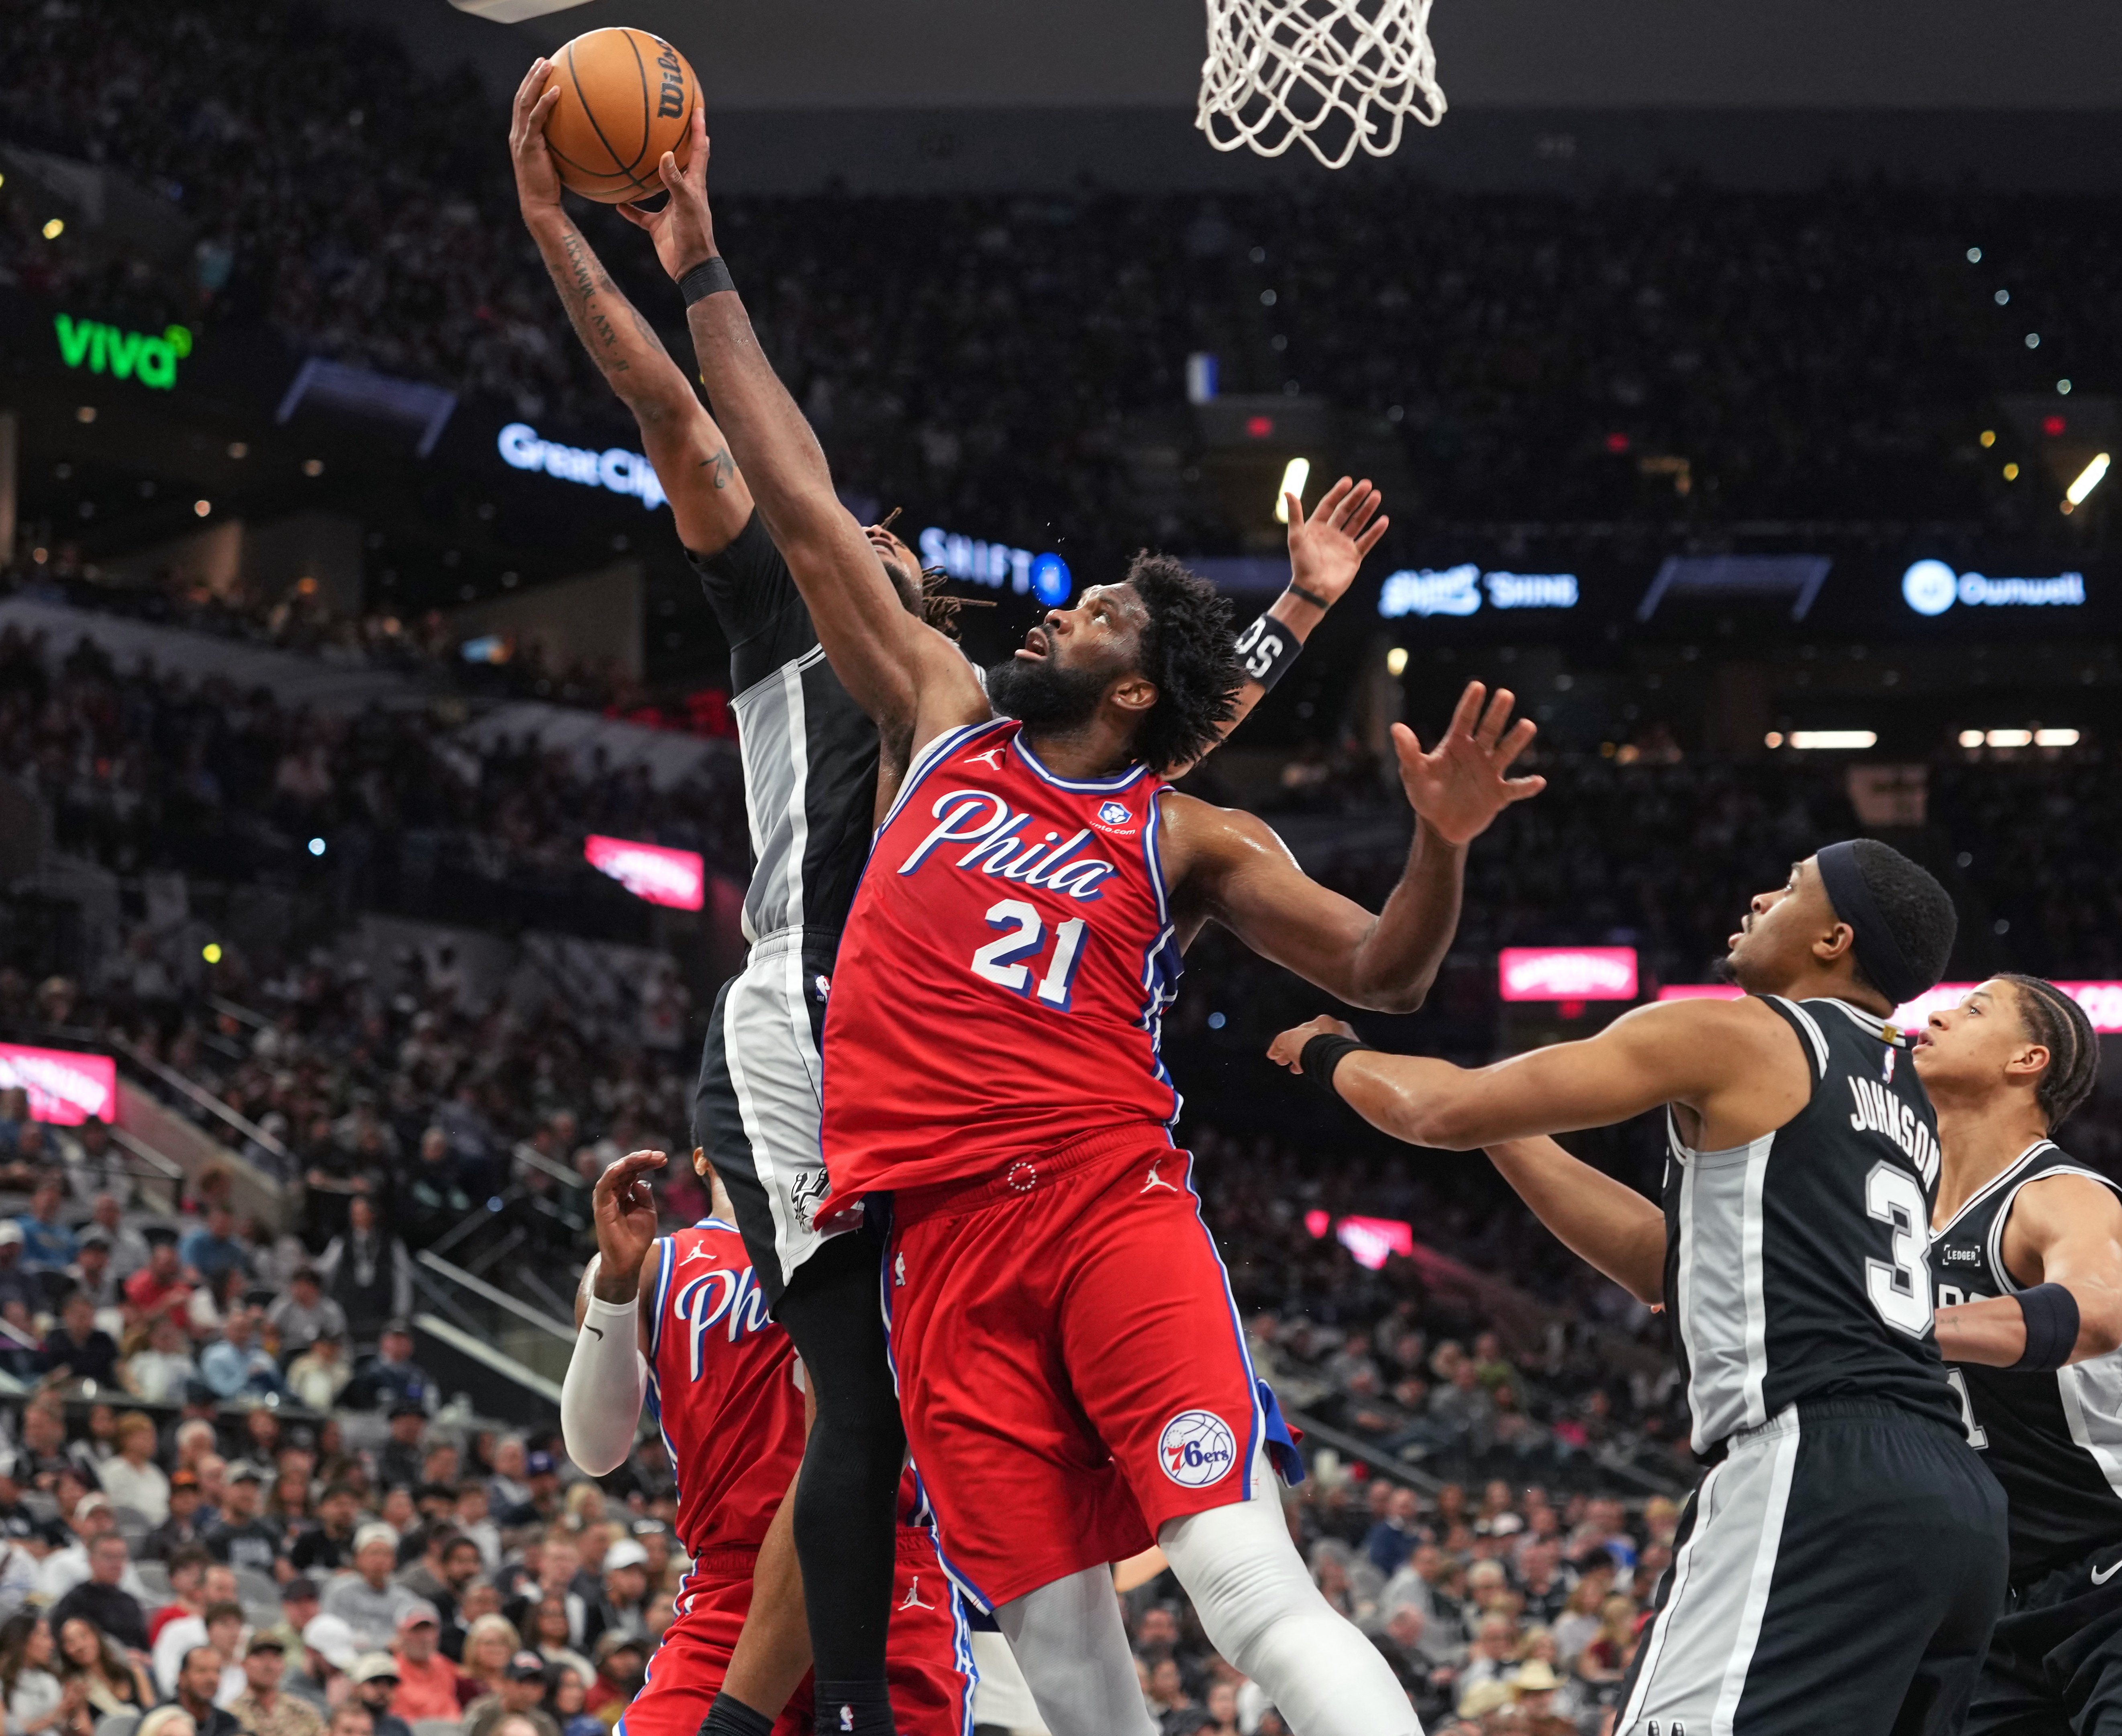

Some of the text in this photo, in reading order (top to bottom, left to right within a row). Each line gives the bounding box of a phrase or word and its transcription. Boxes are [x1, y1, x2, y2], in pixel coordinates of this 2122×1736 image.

[599, 447, 671, 511] Clip
[897, 789, 1119, 903] Phila
[970, 898, 1090, 1013] 21
[1847, 1075, 1941, 1193] JOHNSON
[1865, 1158, 1936, 1340] 3
[1947, 1249, 1976, 1261] LEDGER
[1167, 1441, 1229, 1472] 76ers
